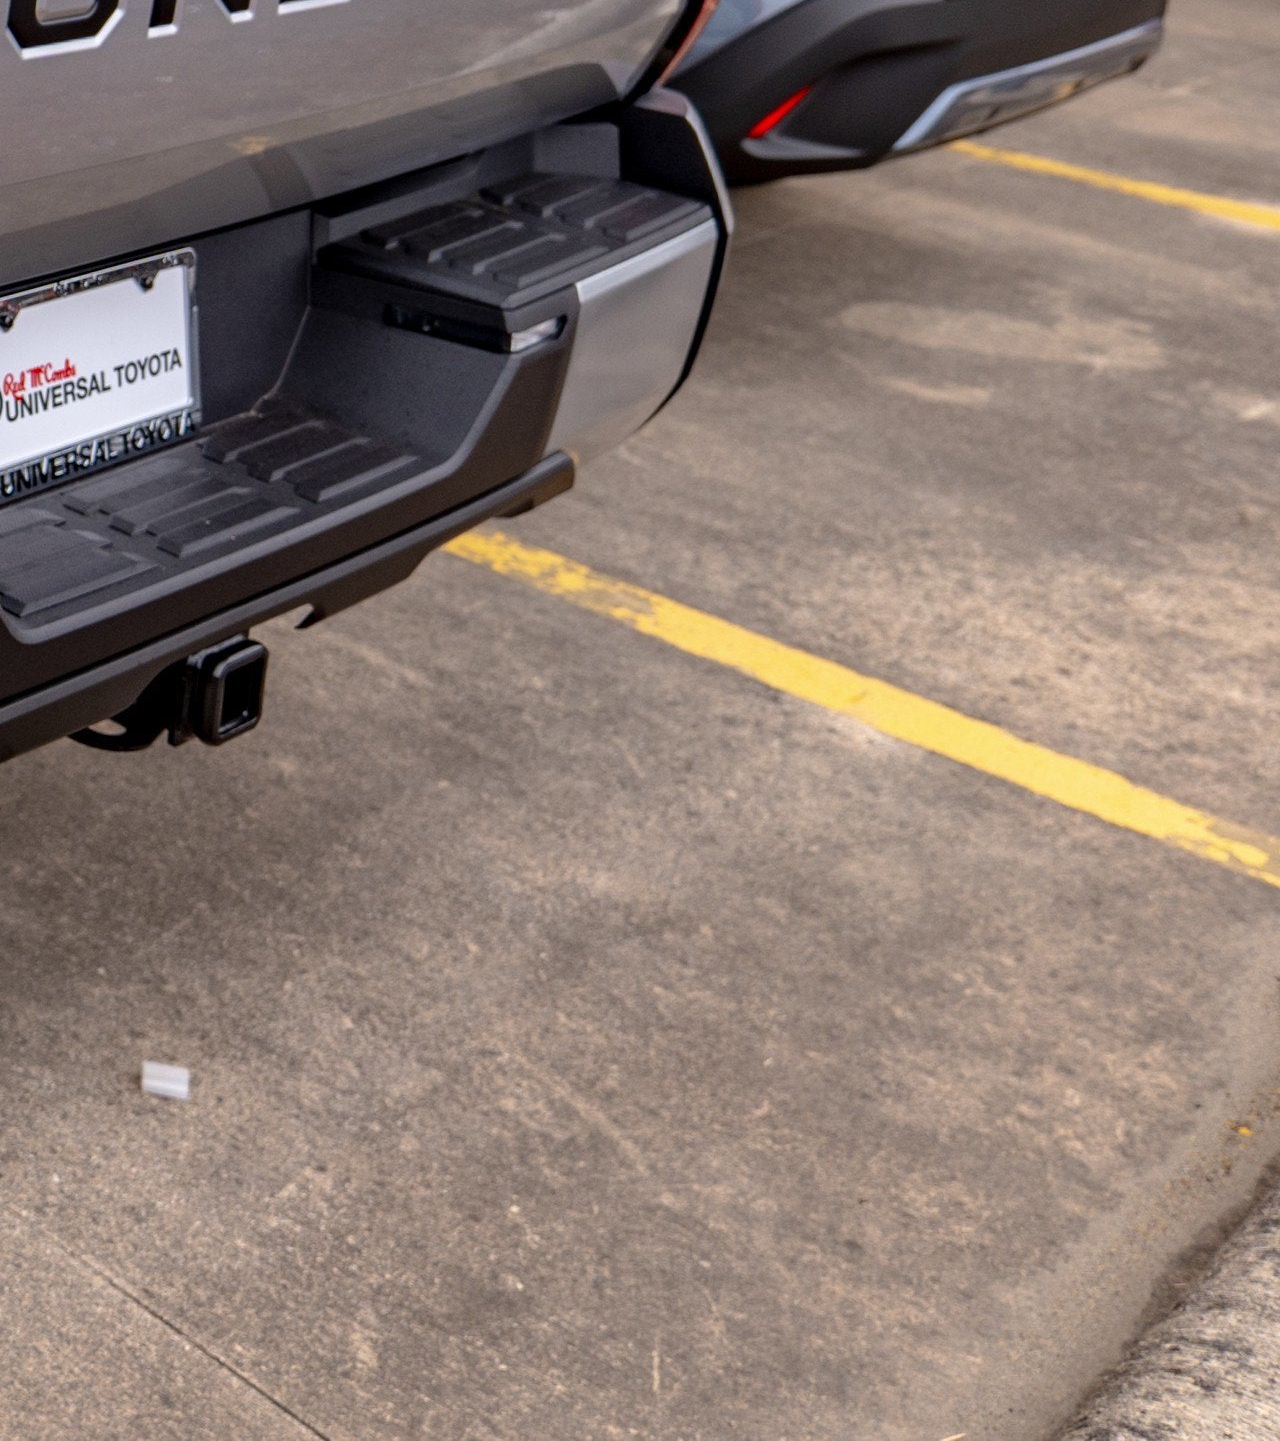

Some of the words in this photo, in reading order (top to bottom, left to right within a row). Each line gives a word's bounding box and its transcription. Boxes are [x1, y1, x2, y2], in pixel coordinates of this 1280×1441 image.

[3, 371, 26, 401] Red
[5, 371, 112, 422] UNIVERSAL
[114, 347, 182, 388] TOYOTA
[0, 439, 119, 496] UNIVERSAL
[119, 409, 197, 456] TOYOTA
